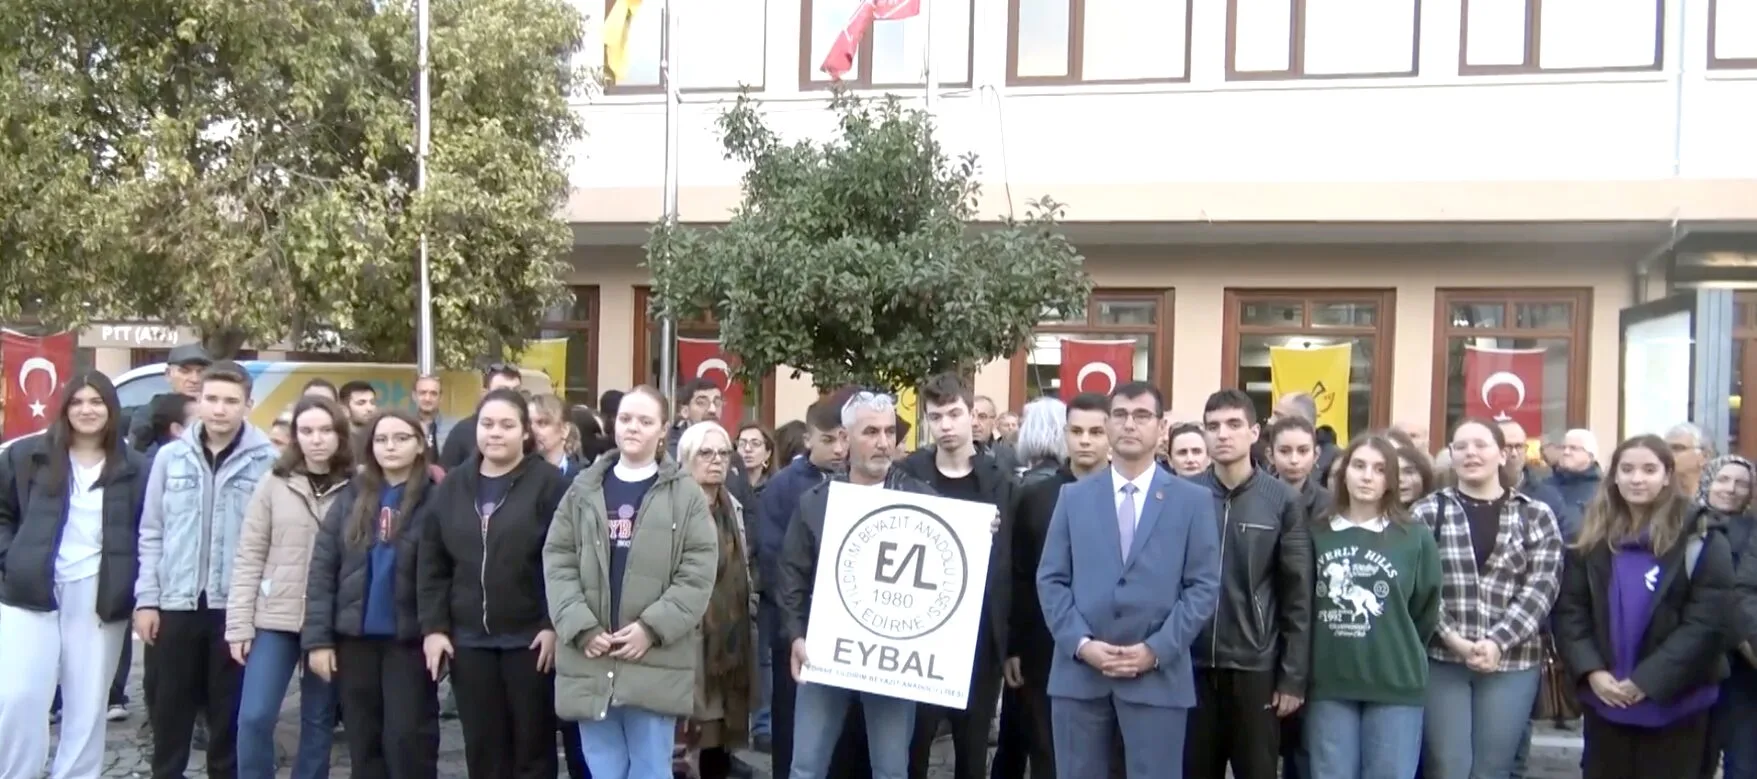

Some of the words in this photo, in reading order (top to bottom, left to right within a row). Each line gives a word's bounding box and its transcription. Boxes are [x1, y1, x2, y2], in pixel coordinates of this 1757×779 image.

[102, 326, 132, 341] PTT
[1317, 545, 1359, 570] VERLY
[1364, 549, 1398, 578] HILLS
[872, 588, 914, 608] 1980
[833, 637, 944, 681] EYBAL
